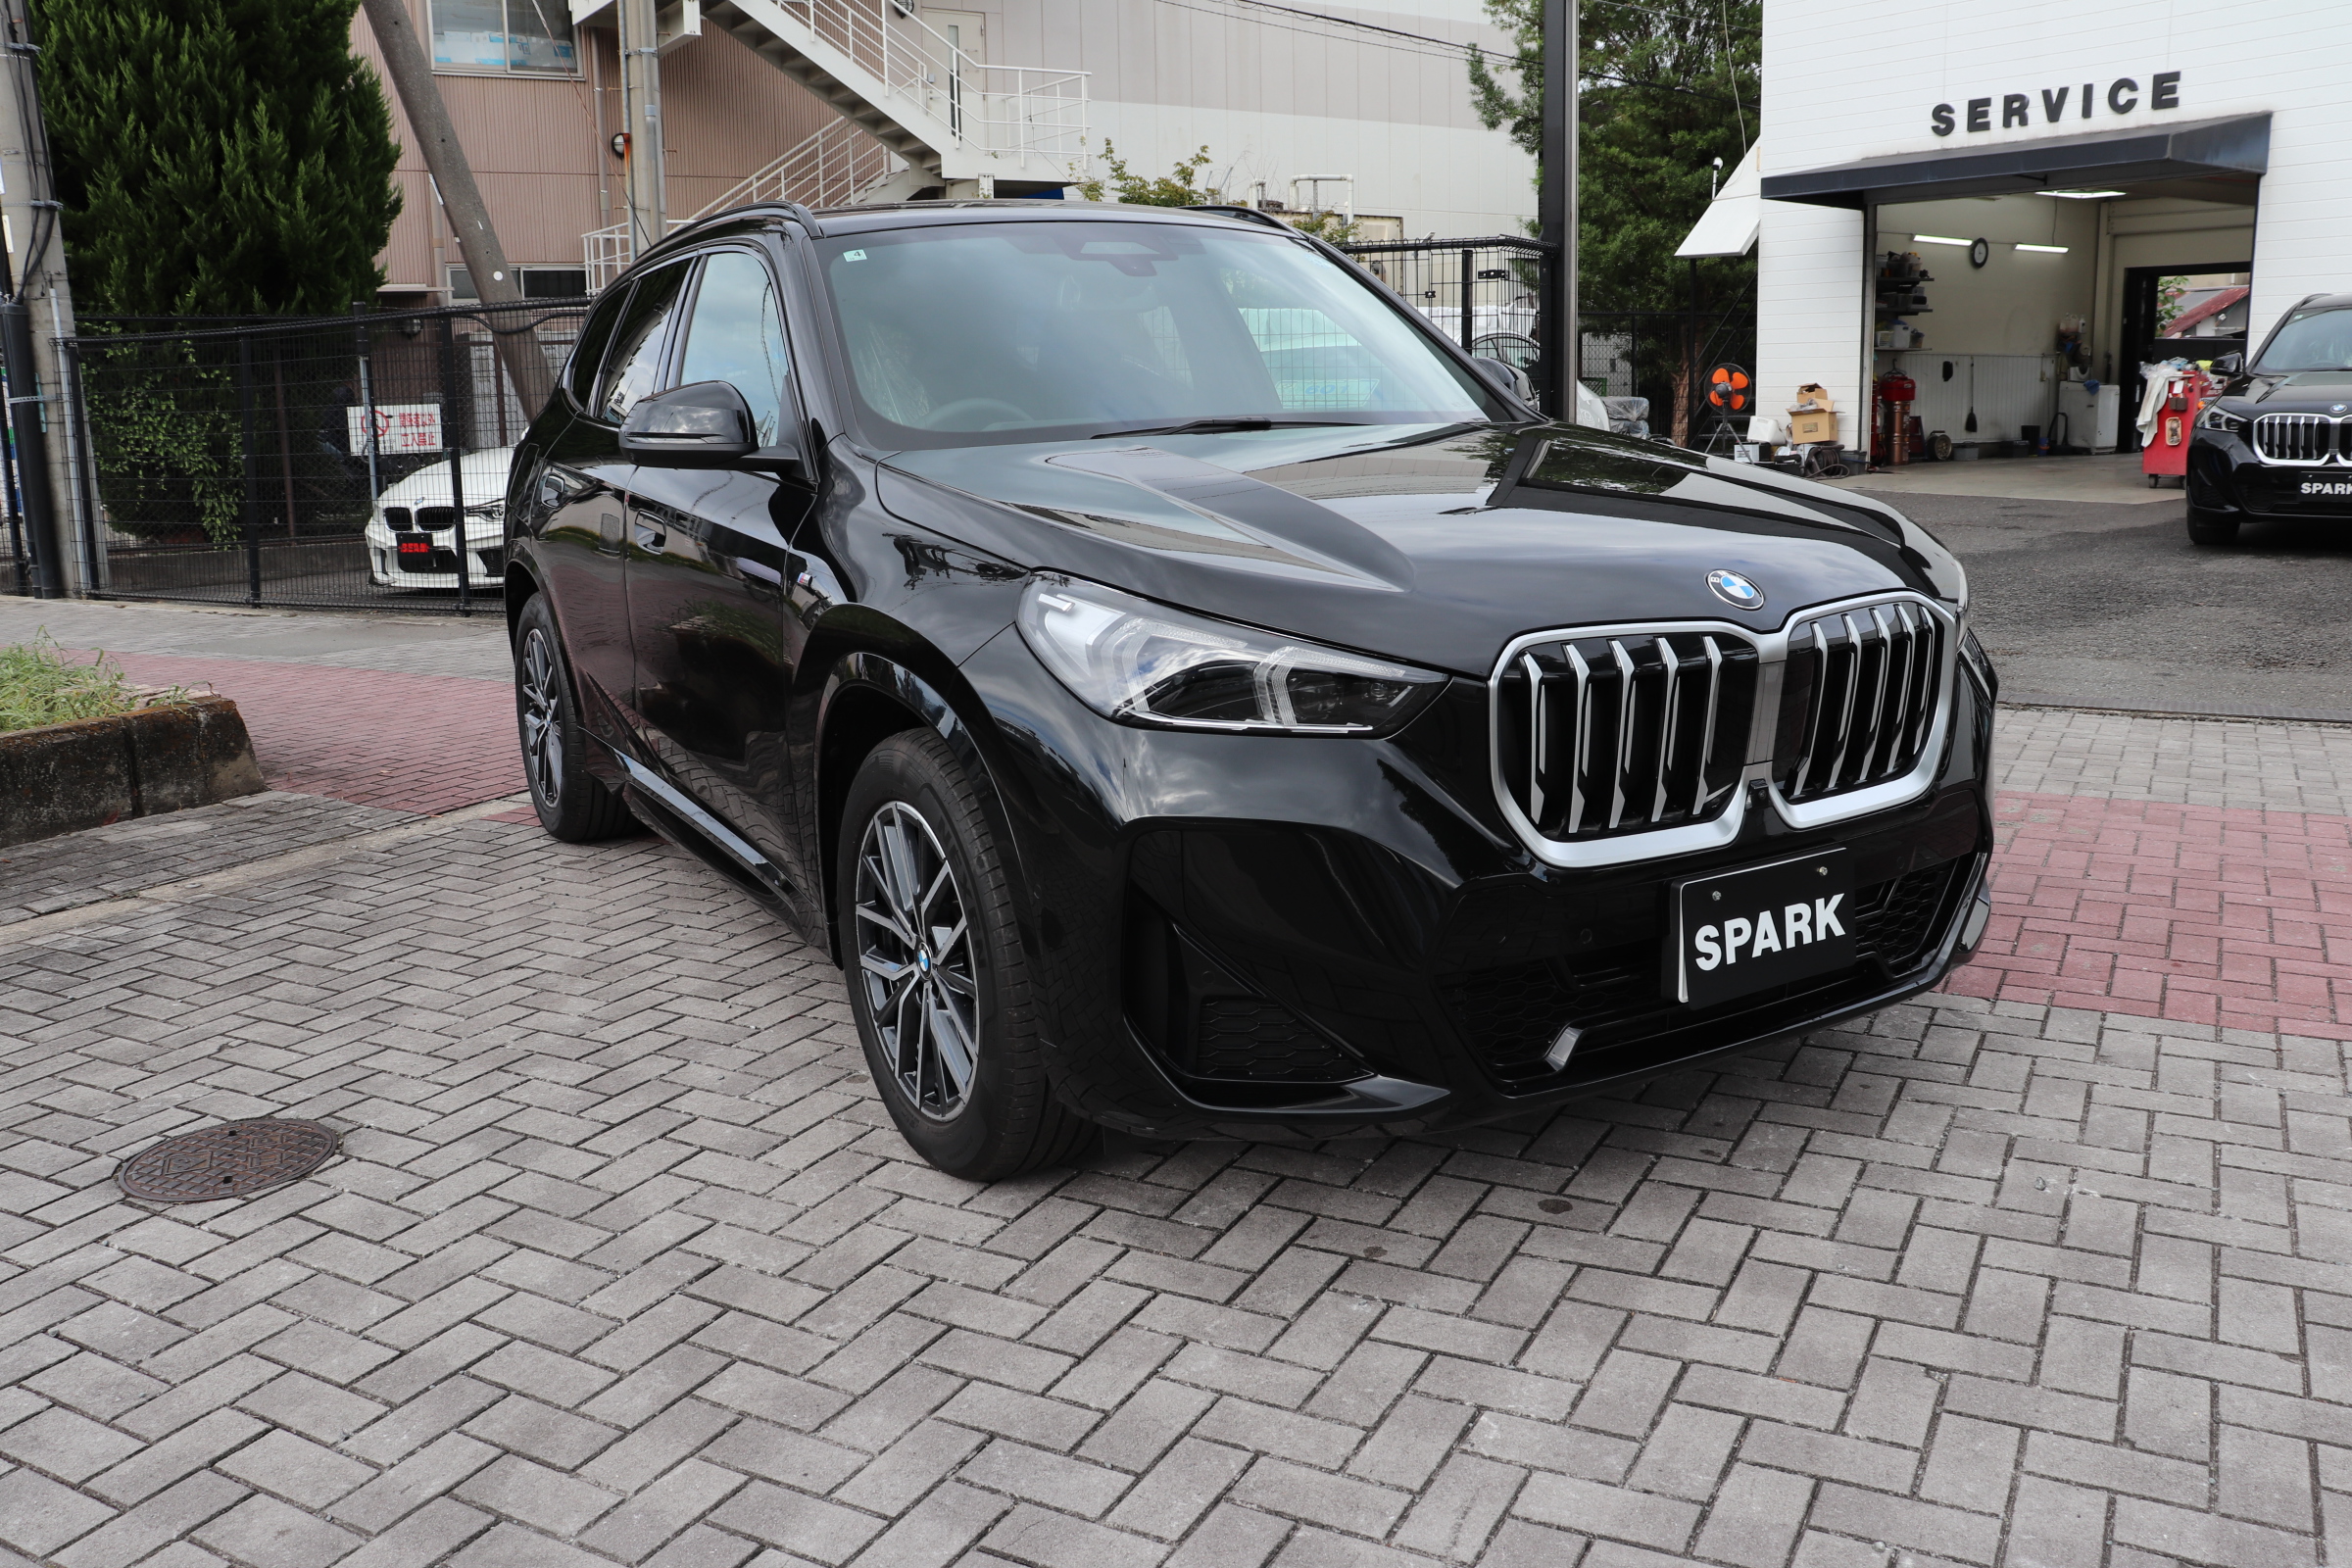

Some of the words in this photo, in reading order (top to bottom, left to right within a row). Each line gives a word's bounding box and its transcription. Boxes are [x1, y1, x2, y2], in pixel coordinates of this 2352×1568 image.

[1931, 71, 2181, 137] SERVICE
[401, 432, 436, 448] 立入禁止
[937, 814, 989, 969] NEXEN
[1693, 892, 1846, 972] SPARK
